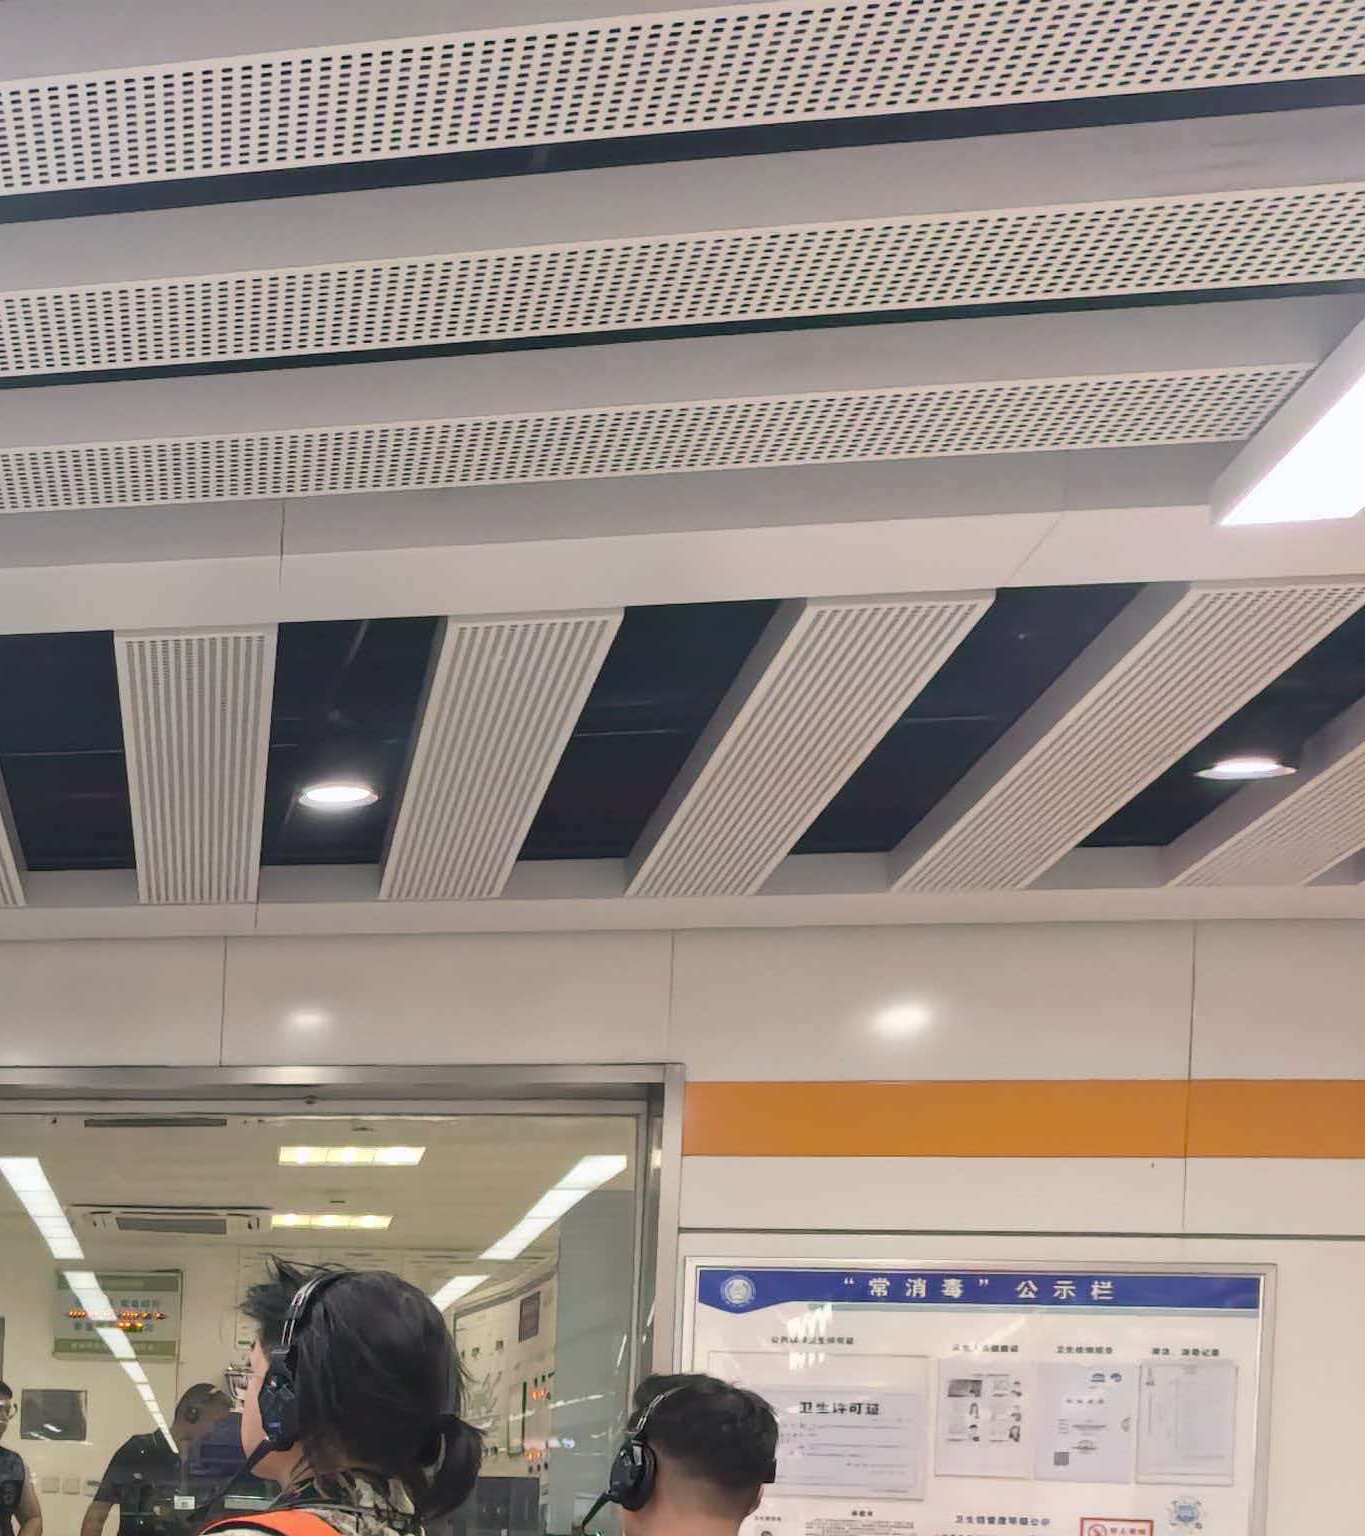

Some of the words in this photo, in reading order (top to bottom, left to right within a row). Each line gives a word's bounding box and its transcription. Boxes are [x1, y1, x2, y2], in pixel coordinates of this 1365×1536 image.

[799, 1401, 880, 1415] 卫生许可证
